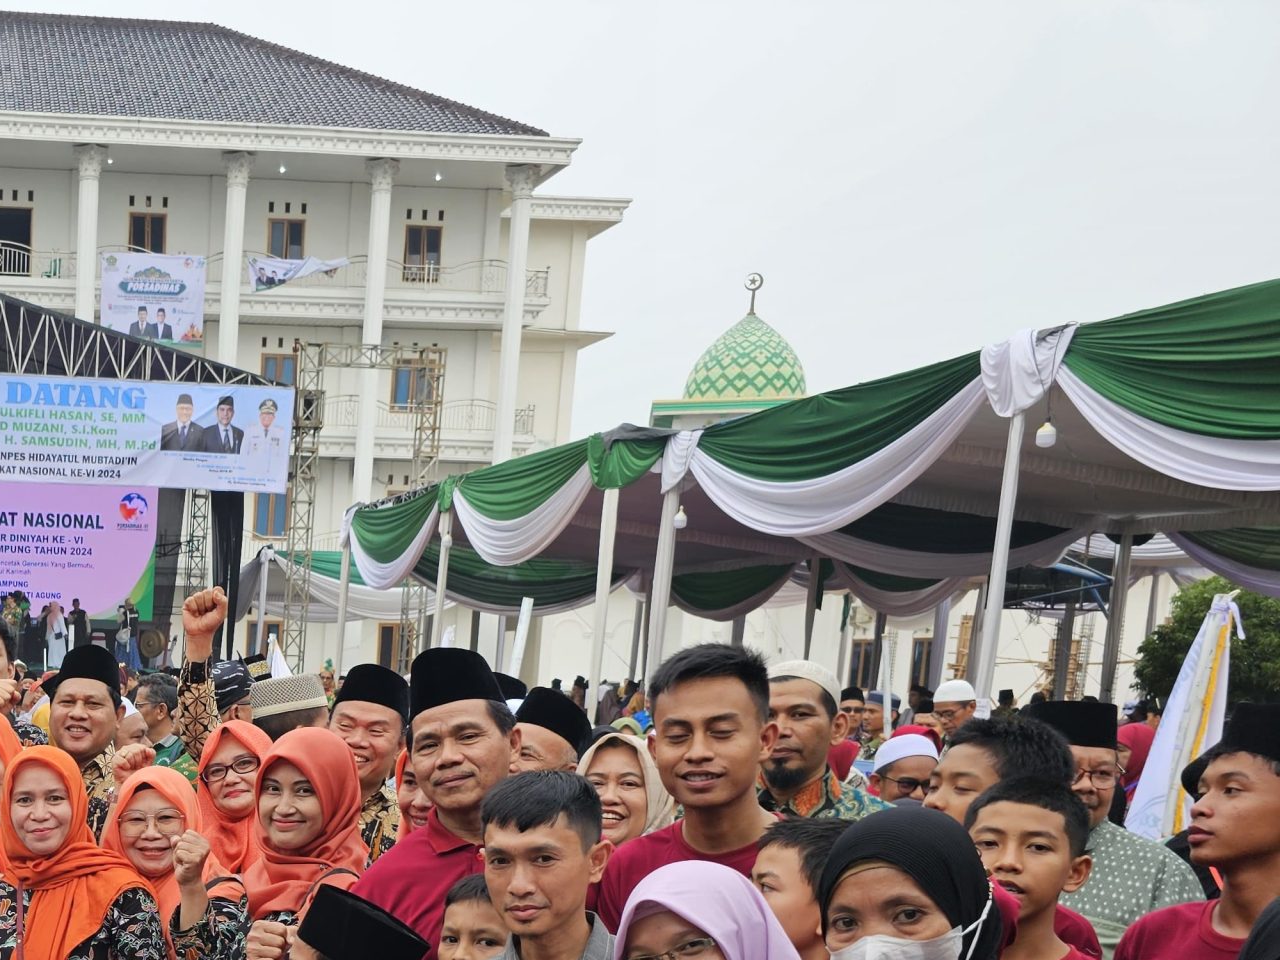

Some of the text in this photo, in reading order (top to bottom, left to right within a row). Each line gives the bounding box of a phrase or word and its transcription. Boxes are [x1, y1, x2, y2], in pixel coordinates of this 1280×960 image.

[6, 381, 148, 410] DATANG
[49, 410, 96, 423] HASAN,
[100, 413, 117, 423] SE,
[122, 413, 145, 424] MM
[12, 422, 67, 434] MUZANI,
[71, 425, 118, 435] S.I.Kom
[4, 435, 17, 445] H.
[21, 436, 91, 450] SAMSUDIN,
[96, 439, 120, 450] MH,
[125, 440, 157, 450] M.Pd
[28, 453, 79, 463] HIDAYATUL
[83, 455, 138, 465] MUBTADI'IN
[19, 467, 67, 477] NASIONAL
[71, 469, 95, 478] KE-VI
[98, 469, 121, 479] 2024
[23, 512, 105, 530] NASIONAL
[10, 534, 49, 544] DINIYAH
[52, 536, 65, 544] KE
[74, 536, 84, 545] VI
[34, 546, 67, 556] TAHUN
[70, 547, 93, 556] 2024
